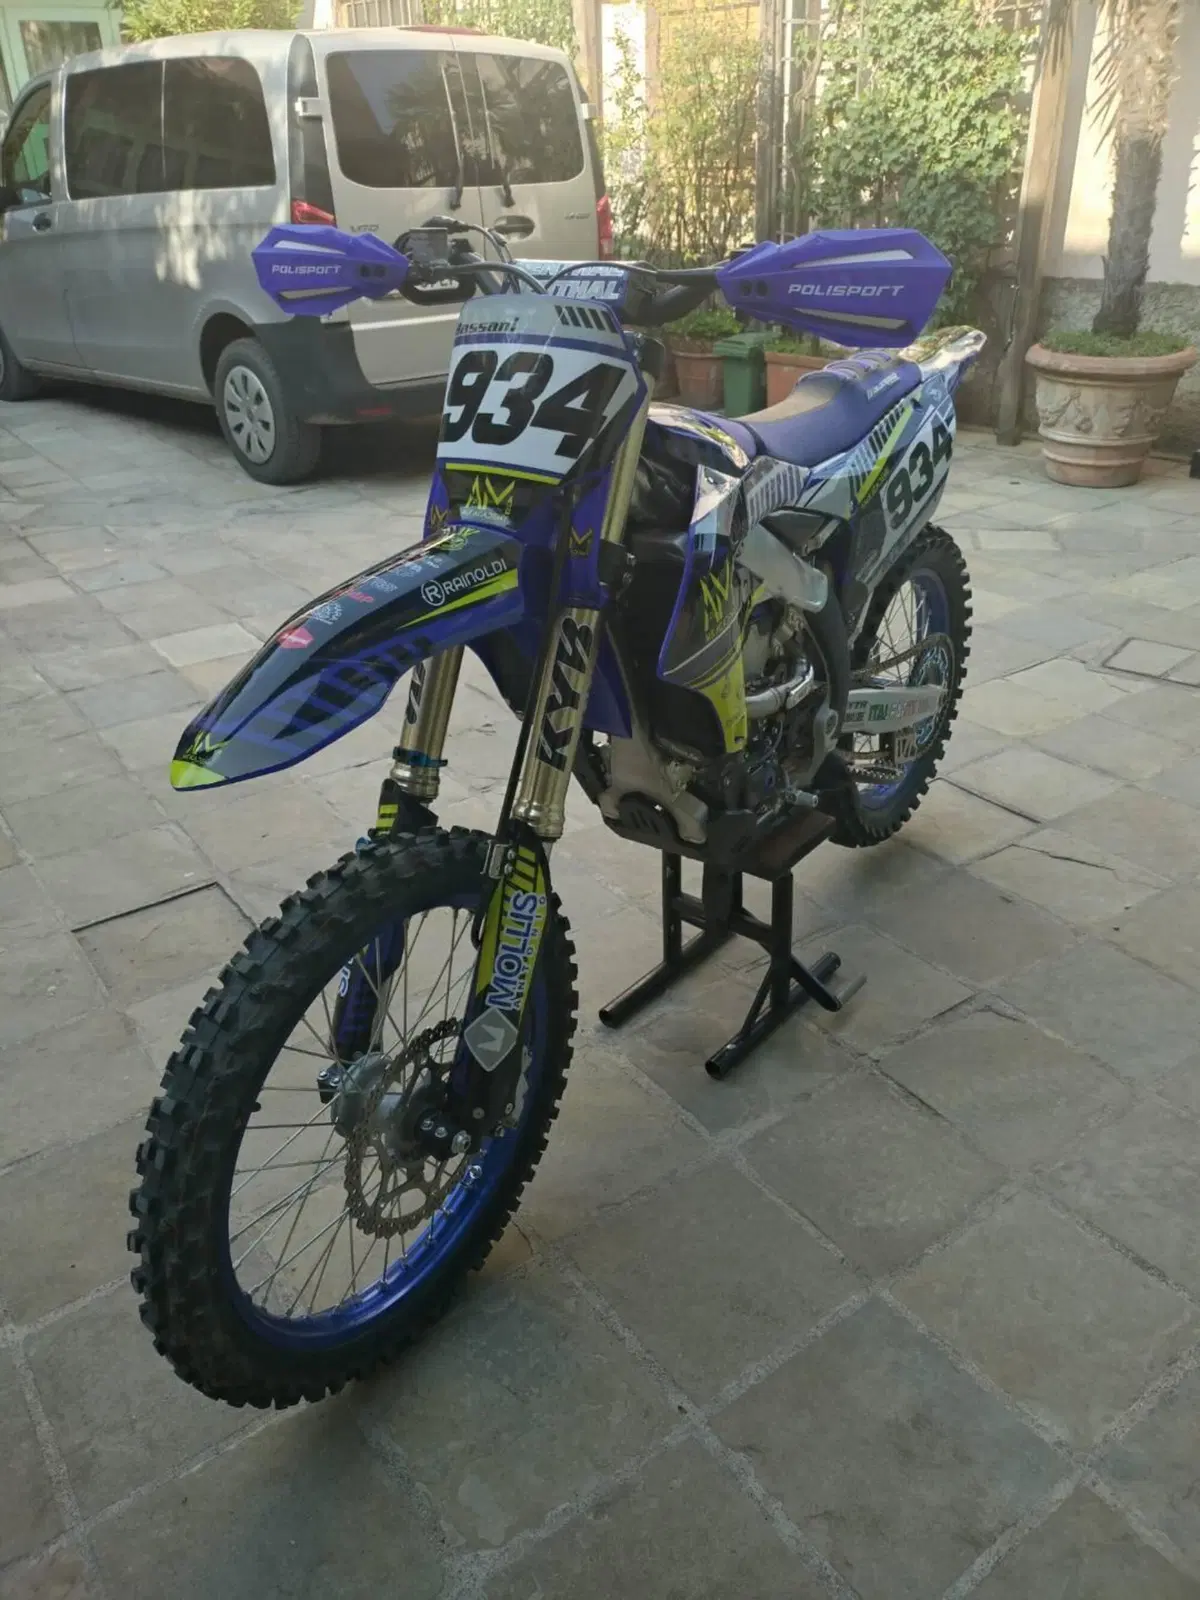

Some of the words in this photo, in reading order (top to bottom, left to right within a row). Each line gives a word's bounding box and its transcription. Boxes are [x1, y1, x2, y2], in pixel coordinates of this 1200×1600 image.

[271, 264, 343, 275] POLISPORT
[788, 283, 904, 297] POLISPORT
[443, 350, 627, 459] 934
[886, 421, 953, 529] 934
[443, 558, 507, 594] RAINOLDI
[537, 616, 594, 772] KYB
[485, 890, 538, 1010] MOLLIS
